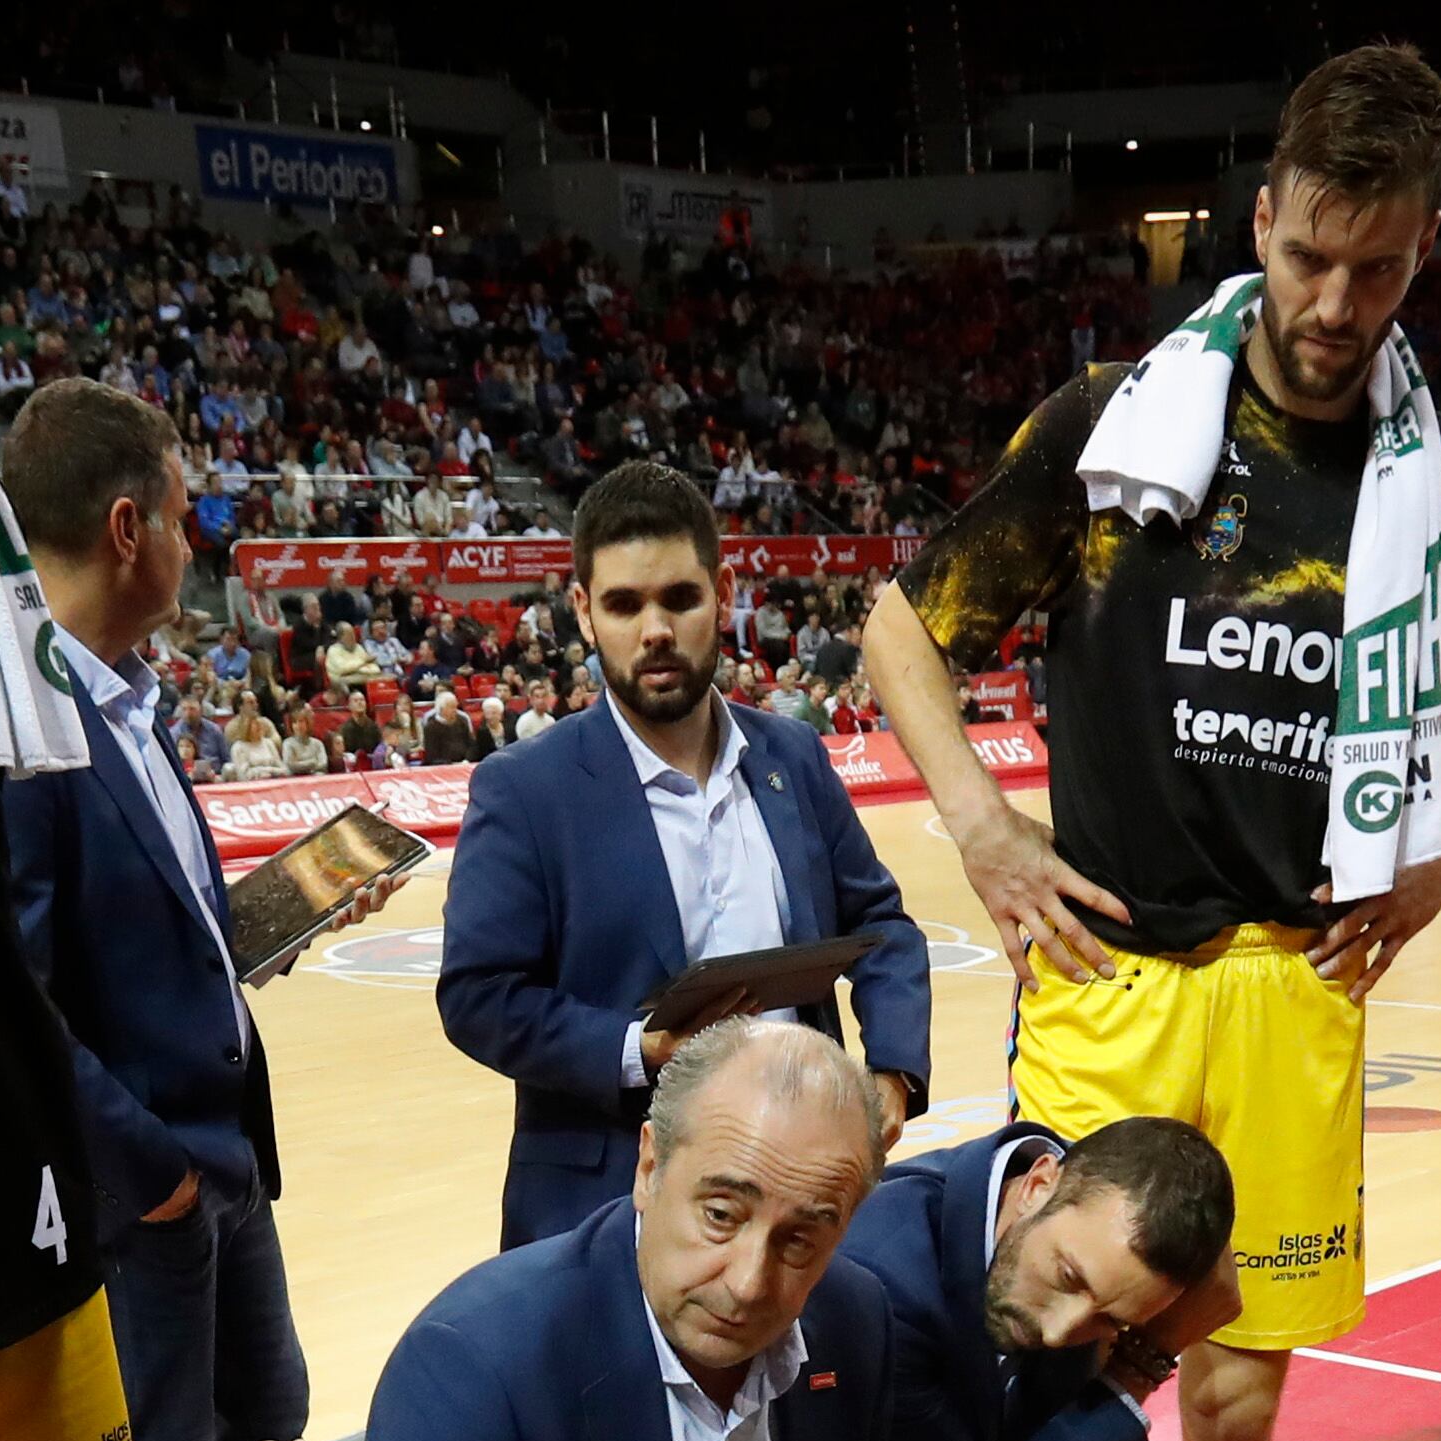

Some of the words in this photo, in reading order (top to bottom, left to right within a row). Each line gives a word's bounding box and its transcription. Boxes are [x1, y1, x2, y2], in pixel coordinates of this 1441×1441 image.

[210, 139, 240, 188] el
[448, 545, 506, 568] ACYF
[1174, 743, 1256, 769] despierta
[1343, 741, 1390, 765] SALUD
[31, 1164, 68, 1267] 4
[1279, 1233, 1323, 1252] Islas
[1232, 1249, 1323, 1269] Canarias
